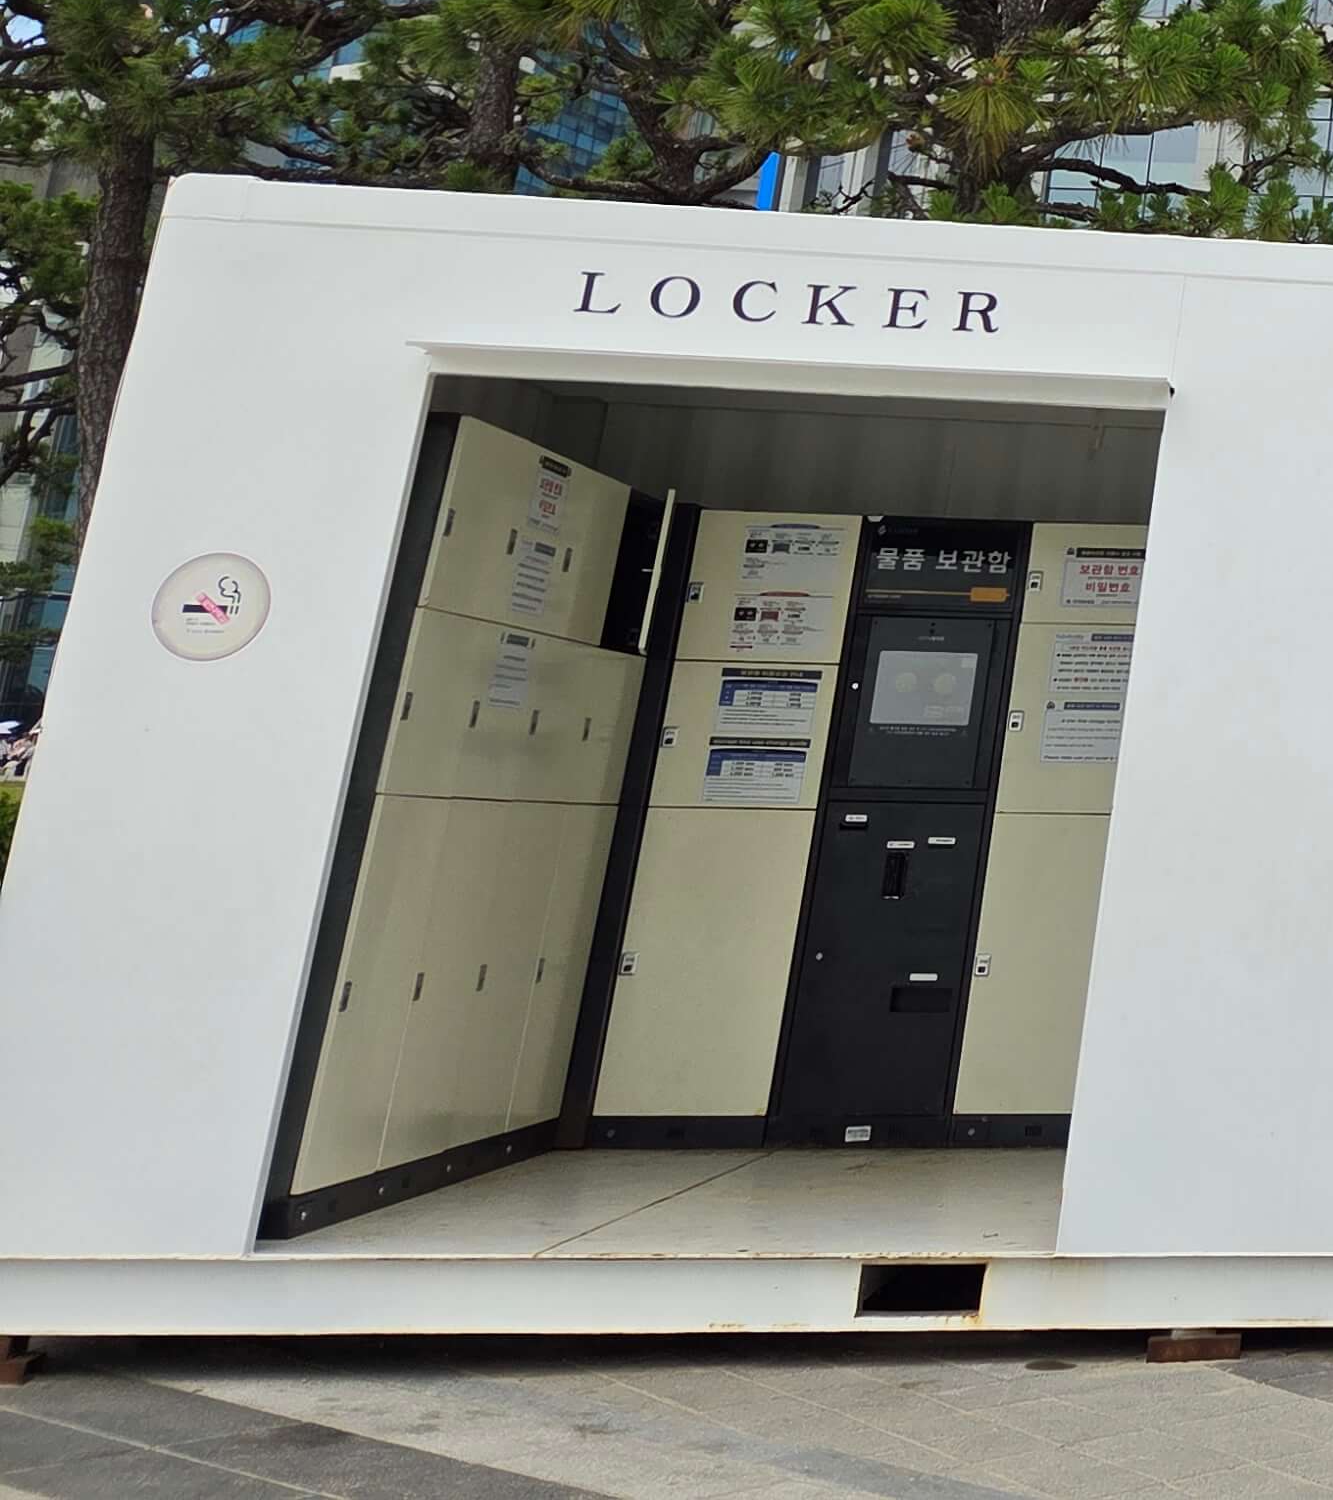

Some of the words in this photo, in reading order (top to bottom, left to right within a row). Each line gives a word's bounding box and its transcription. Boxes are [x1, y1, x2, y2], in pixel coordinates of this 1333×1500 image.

[572, 271, 1002, 334] LOCKER
[876, 547, 926, 572] 물품
[935, 549, 1012, 575] 보관함
[1080, 564, 1114, 575] 보관함
[1118, 565, 1139, 575] 번호
[1086, 581, 1130, 592] 비밀번호
